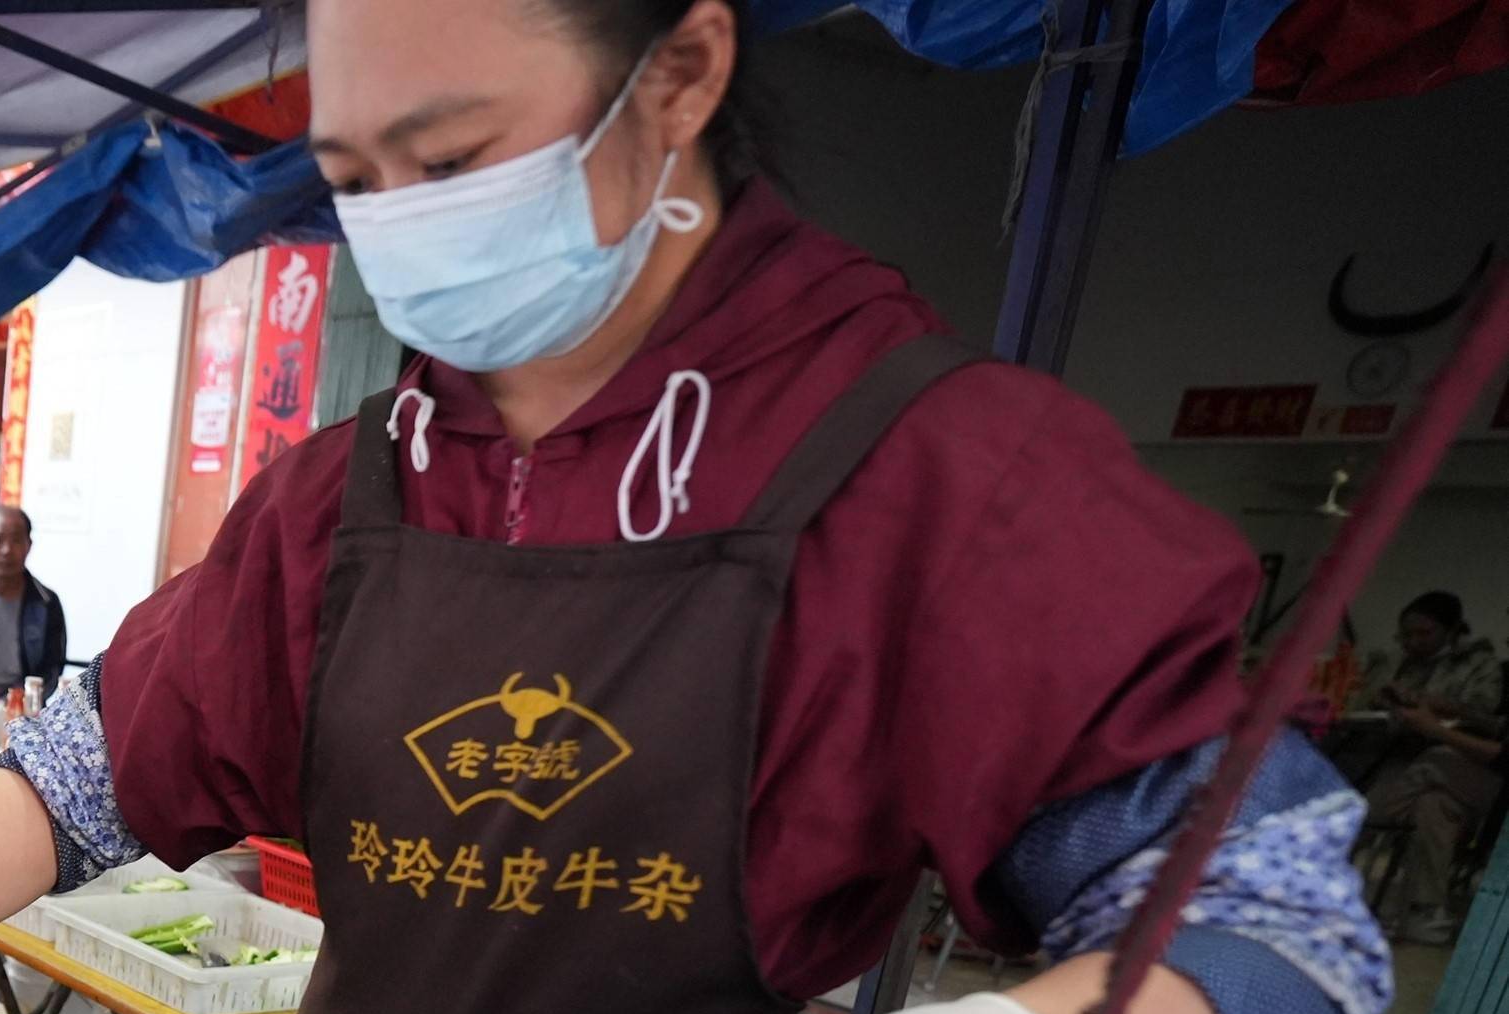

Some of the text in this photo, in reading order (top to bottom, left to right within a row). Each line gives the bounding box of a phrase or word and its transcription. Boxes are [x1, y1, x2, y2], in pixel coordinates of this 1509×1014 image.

[445, 738, 581, 783] 老字號
[347, 820, 703, 922] 玲玲牛皮牛杂
